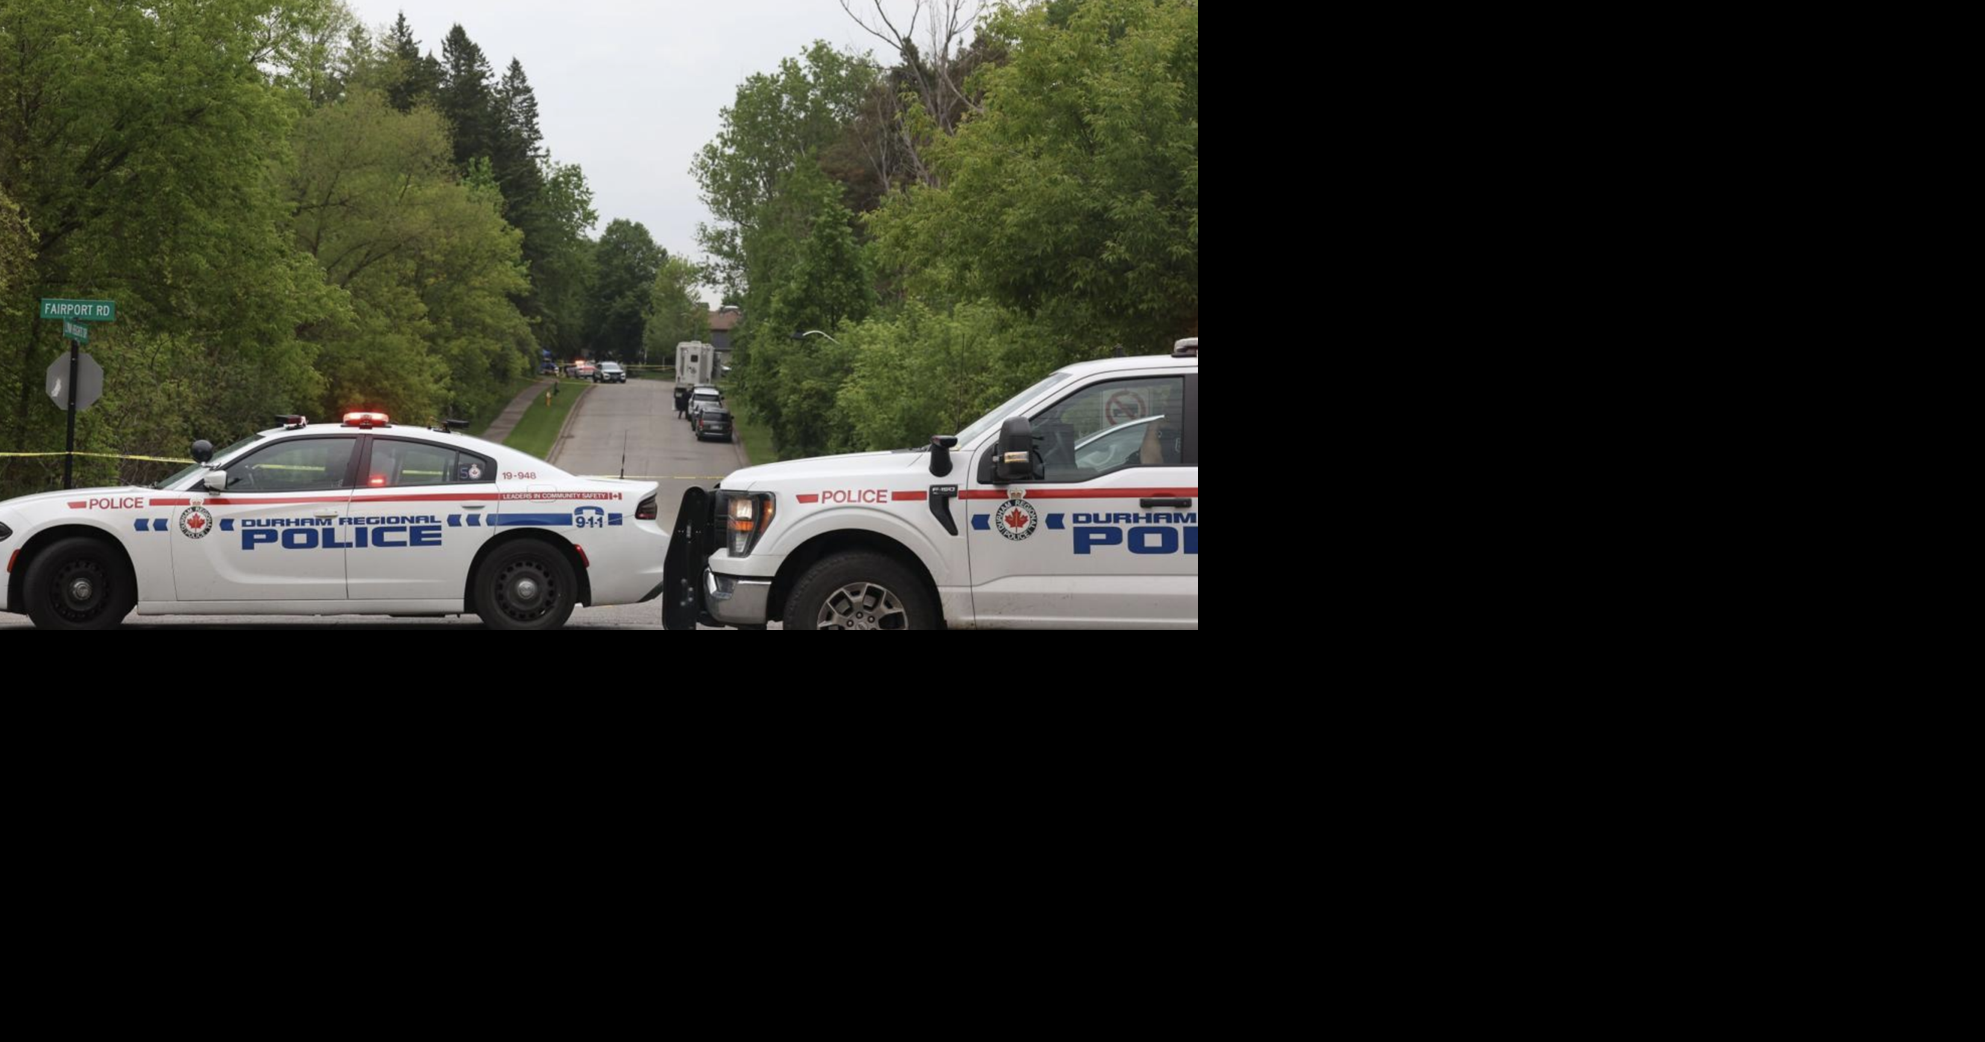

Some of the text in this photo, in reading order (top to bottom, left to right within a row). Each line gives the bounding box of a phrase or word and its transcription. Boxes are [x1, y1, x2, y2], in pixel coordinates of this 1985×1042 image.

[44, 303, 111, 316] FAIRPORT RD
[502, 471, 537, 480] 19-948
[822, 489, 888, 504] POLICE
[89, 497, 144, 510] POLICE
[241, 515, 442, 528] DURHAM REGIONAL
[1072, 512, 1197, 524] DURHAM
[241, 525, 442, 551] POLICE
